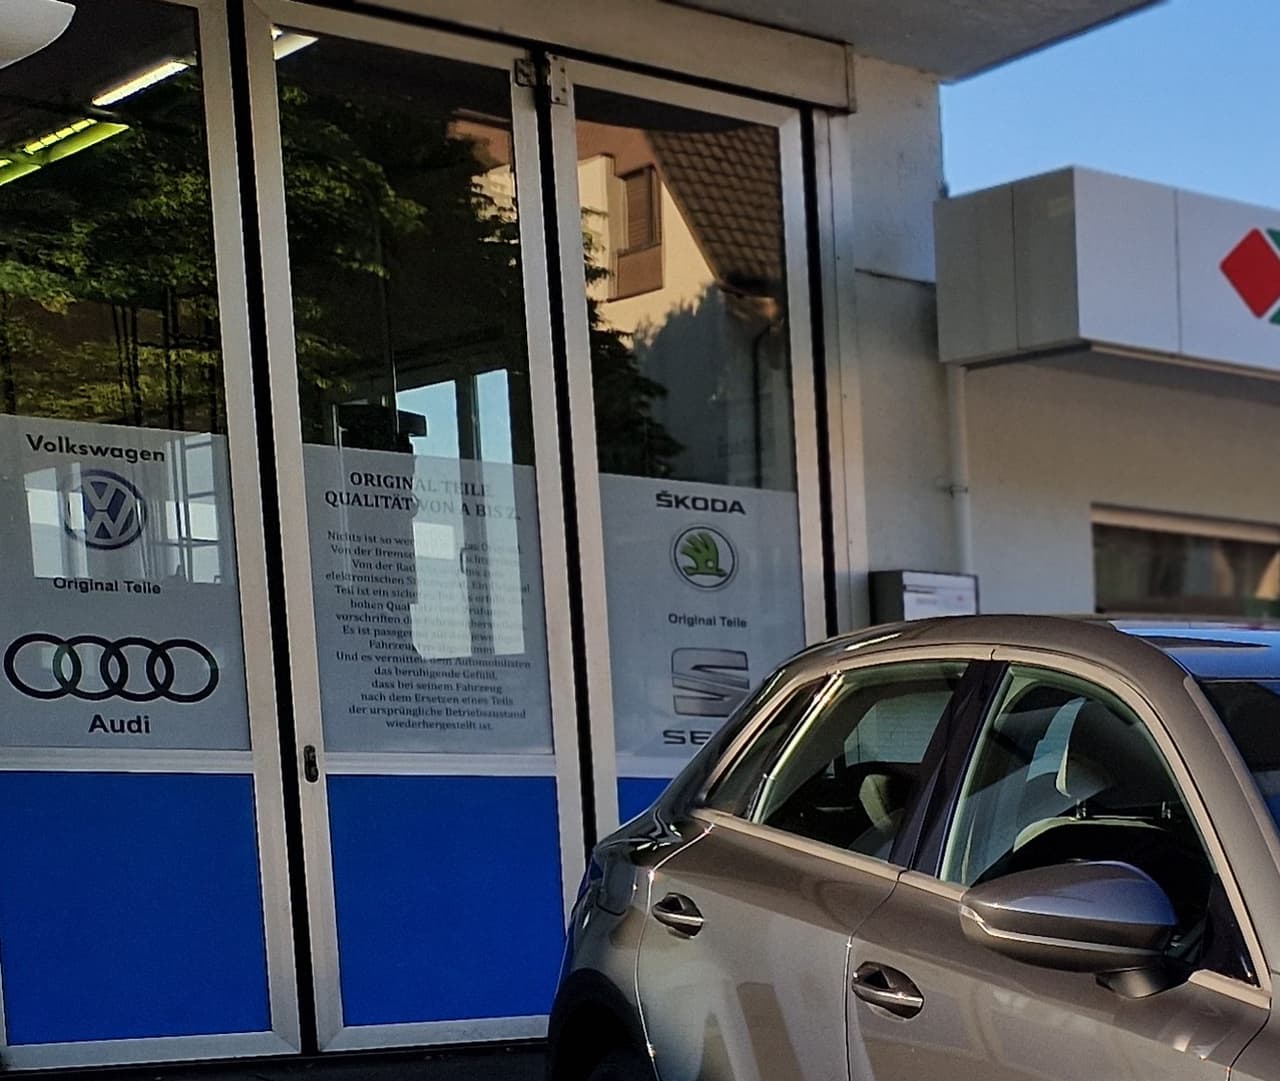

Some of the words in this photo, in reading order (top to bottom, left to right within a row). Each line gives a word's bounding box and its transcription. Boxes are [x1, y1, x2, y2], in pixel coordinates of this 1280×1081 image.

[26, 433, 165, 463] Volkswagen
[350, 471, 438, 493] ORIGINAL
[325, 490, 413, 511] QUALITÄT
[461, 503, 470, 516] A
[655, 490, 746, 516] ŠKODA
[53, 577, 119, 594] Original
[122, 579, 161, 595] Teile
[668, 612, 717, 628] Original
[719, 616, 748, 629] Teile
[88, 714, 151, 735] Audi
[662, 729, 713, 745] SE
